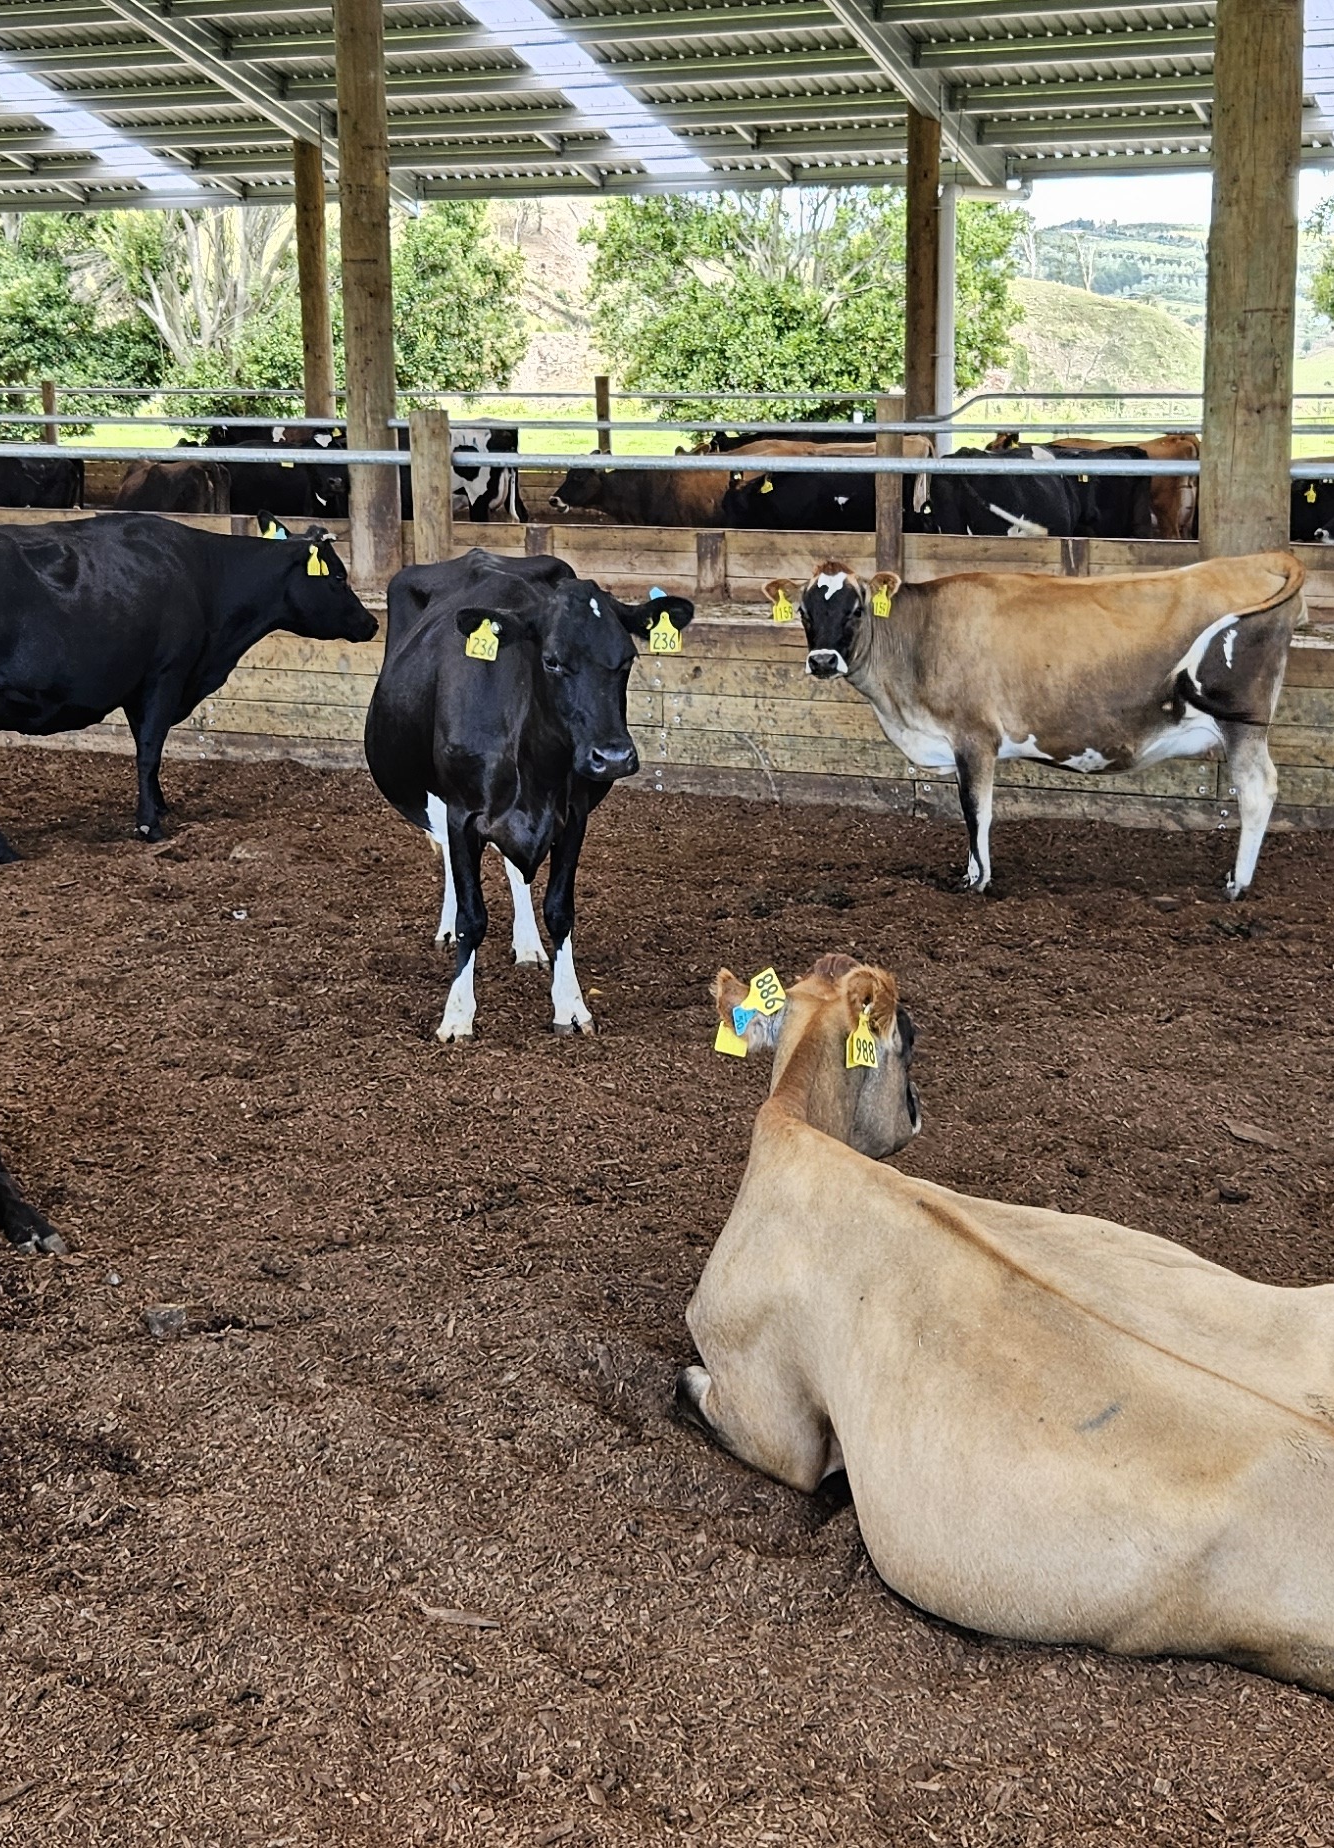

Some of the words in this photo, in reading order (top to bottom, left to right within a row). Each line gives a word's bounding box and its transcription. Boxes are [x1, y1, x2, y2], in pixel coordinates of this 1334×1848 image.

[779, 606, 793, 619] 159
[471, 637, 495, 657] 236
[653, 632, 676, 650] 236
[756, 973, 786, 1010] 988
[856, 1037, 876, 1065] 988
